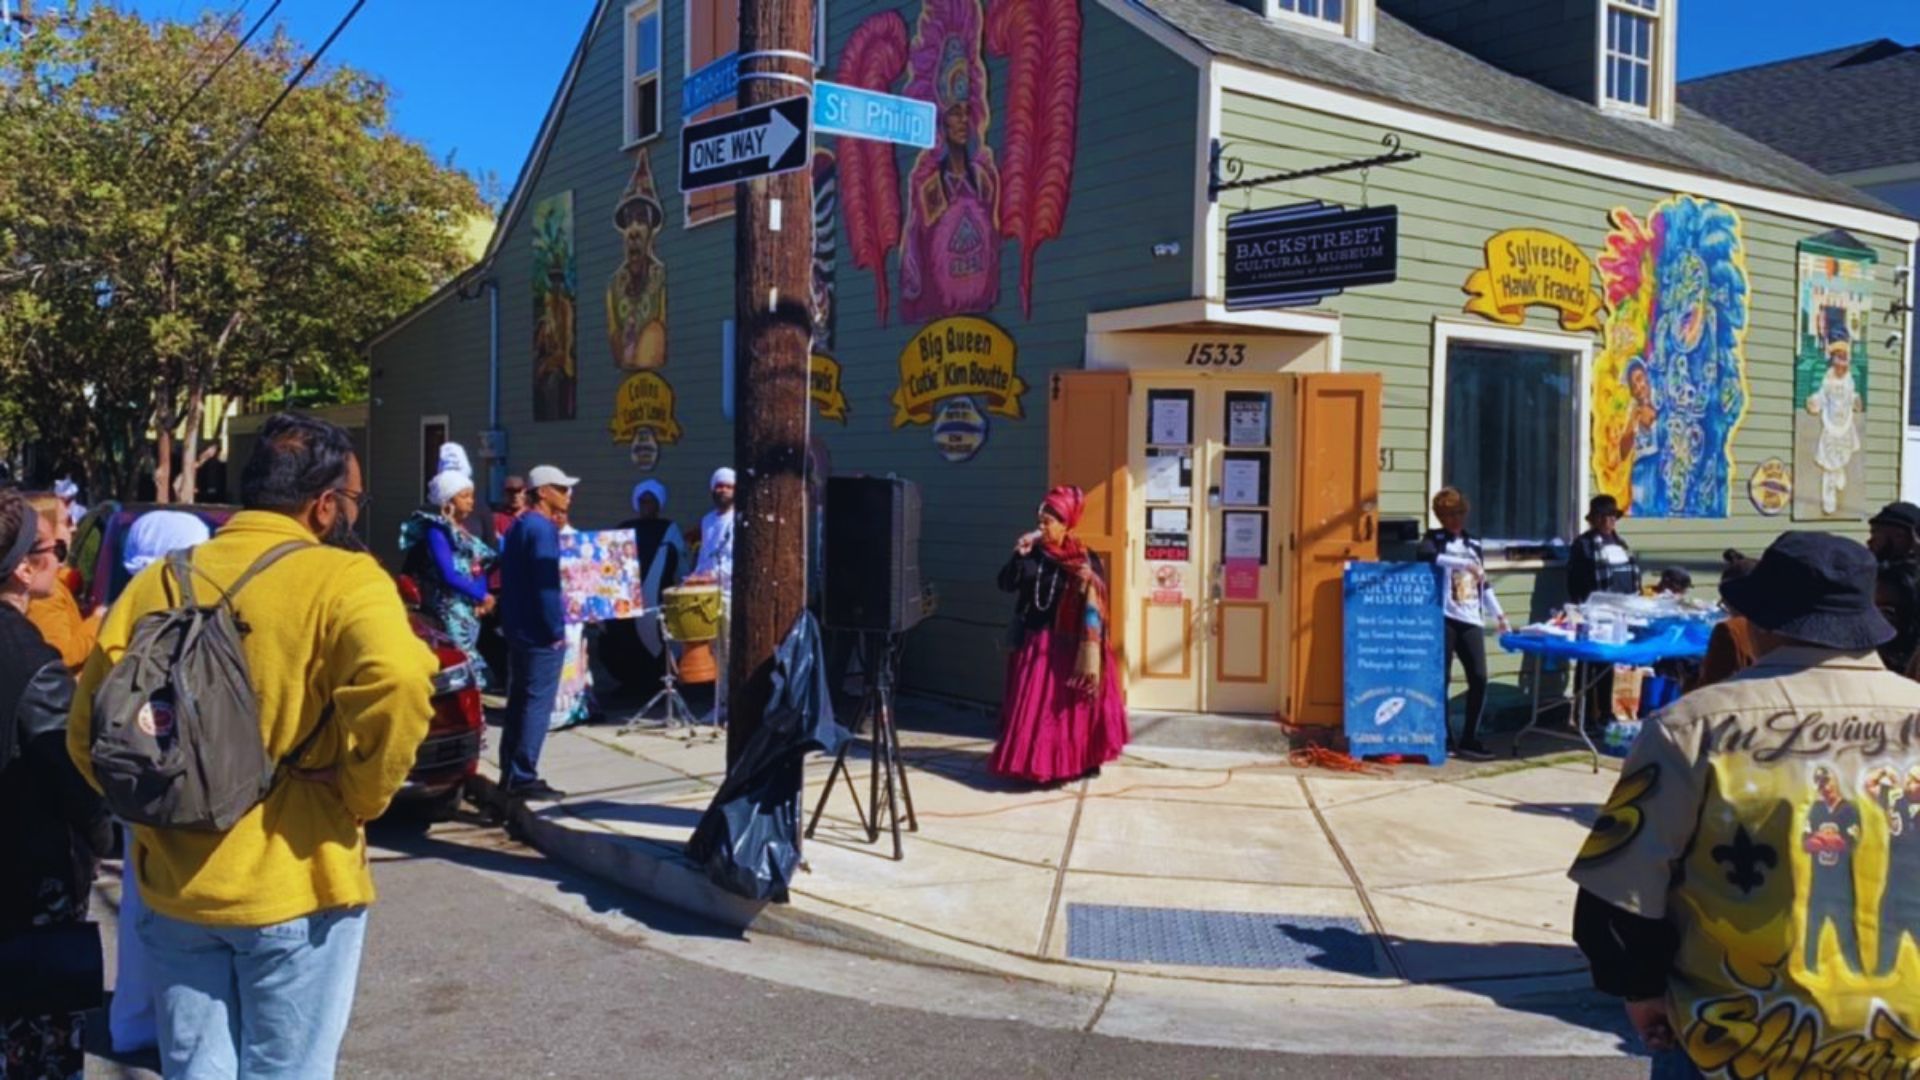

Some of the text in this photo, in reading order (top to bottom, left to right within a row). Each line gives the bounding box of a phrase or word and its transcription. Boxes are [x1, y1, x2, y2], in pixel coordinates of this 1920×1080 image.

[824, 92, 924, 141] St Philip
[693, 127, 768, 169] ONE WAY
[1234, 256, 1313, 273] CULTURAL
[1316, 244, 1385, 264] MUSEUM
[1236, 226, 1385, 260] BACKSTREET
[1506, 239, 1580, 275] Sylvester
[1543, 275, 1585, 307] Francis
[919, 326, 992, 364] Big Queen
[1184, 343, 1246, 367] 1533
[1146, 547, 1187, 560] OPEN
[1356, 583, 1432, 596] CULTURAL
[1363, 594, 1424, 606] MUSEUM
[1752, 710, 1888, 763] Loving
